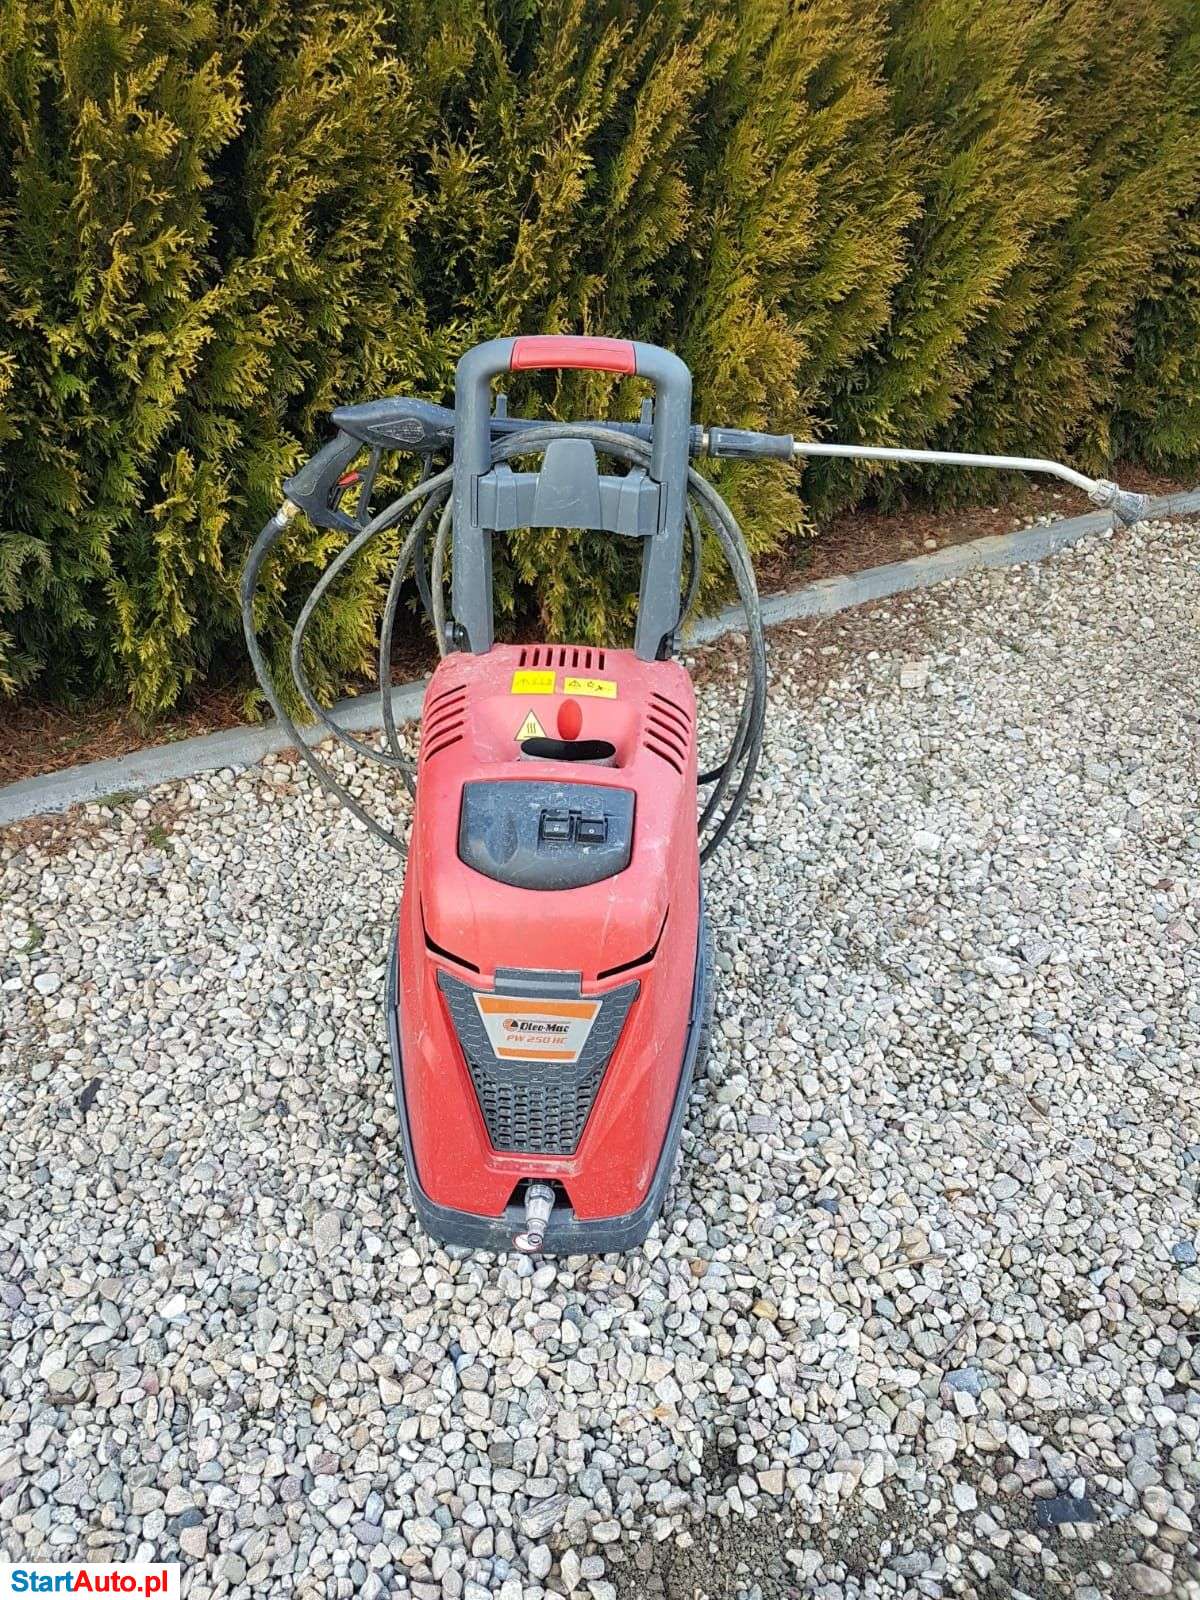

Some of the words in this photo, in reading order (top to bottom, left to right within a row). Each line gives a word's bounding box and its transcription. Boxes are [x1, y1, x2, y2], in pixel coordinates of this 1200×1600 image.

[519, 1022, 570, 1033] Oleo-Mac
[506, 1034, 524, 1042] PW
[527, 1036, 551, 1044] 250
